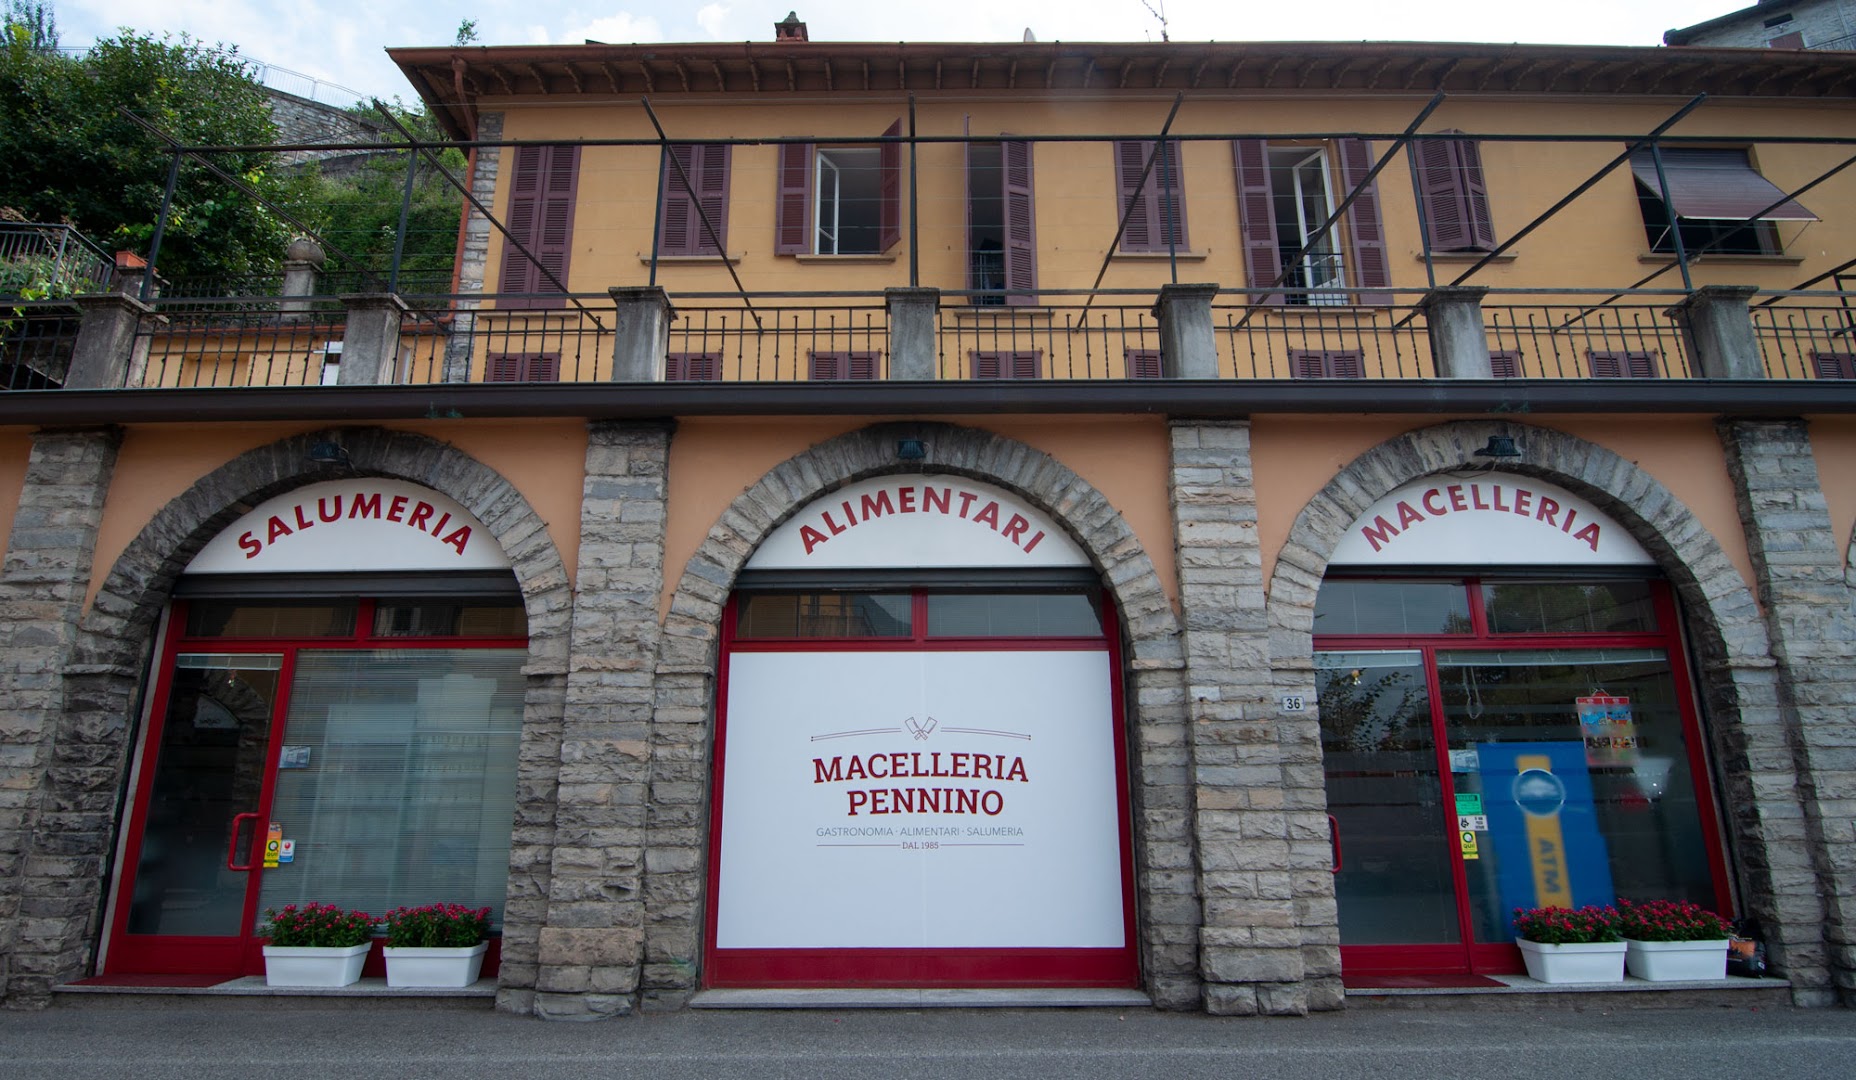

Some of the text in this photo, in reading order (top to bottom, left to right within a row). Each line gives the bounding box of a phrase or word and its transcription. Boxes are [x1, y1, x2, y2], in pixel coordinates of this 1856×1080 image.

[238, 493, 472, 559] SALUMERIA
[800, 486, 1045, 555] ALIMENTARI
[1361, 484, 1600, 552] MACELLERIA
[1286, 698, 1300, 709] 36
[812, 752, 1029, 783] MACELLERIA
[847, 788, 1004, 816] PENNINO
[816, 827, 1024, 837] GASTRONOMIA ALIMENTARI SALUMERIA
[902, 841, 939, 850] DAL 1985
[1540, 838, 1561, 894] ATM
